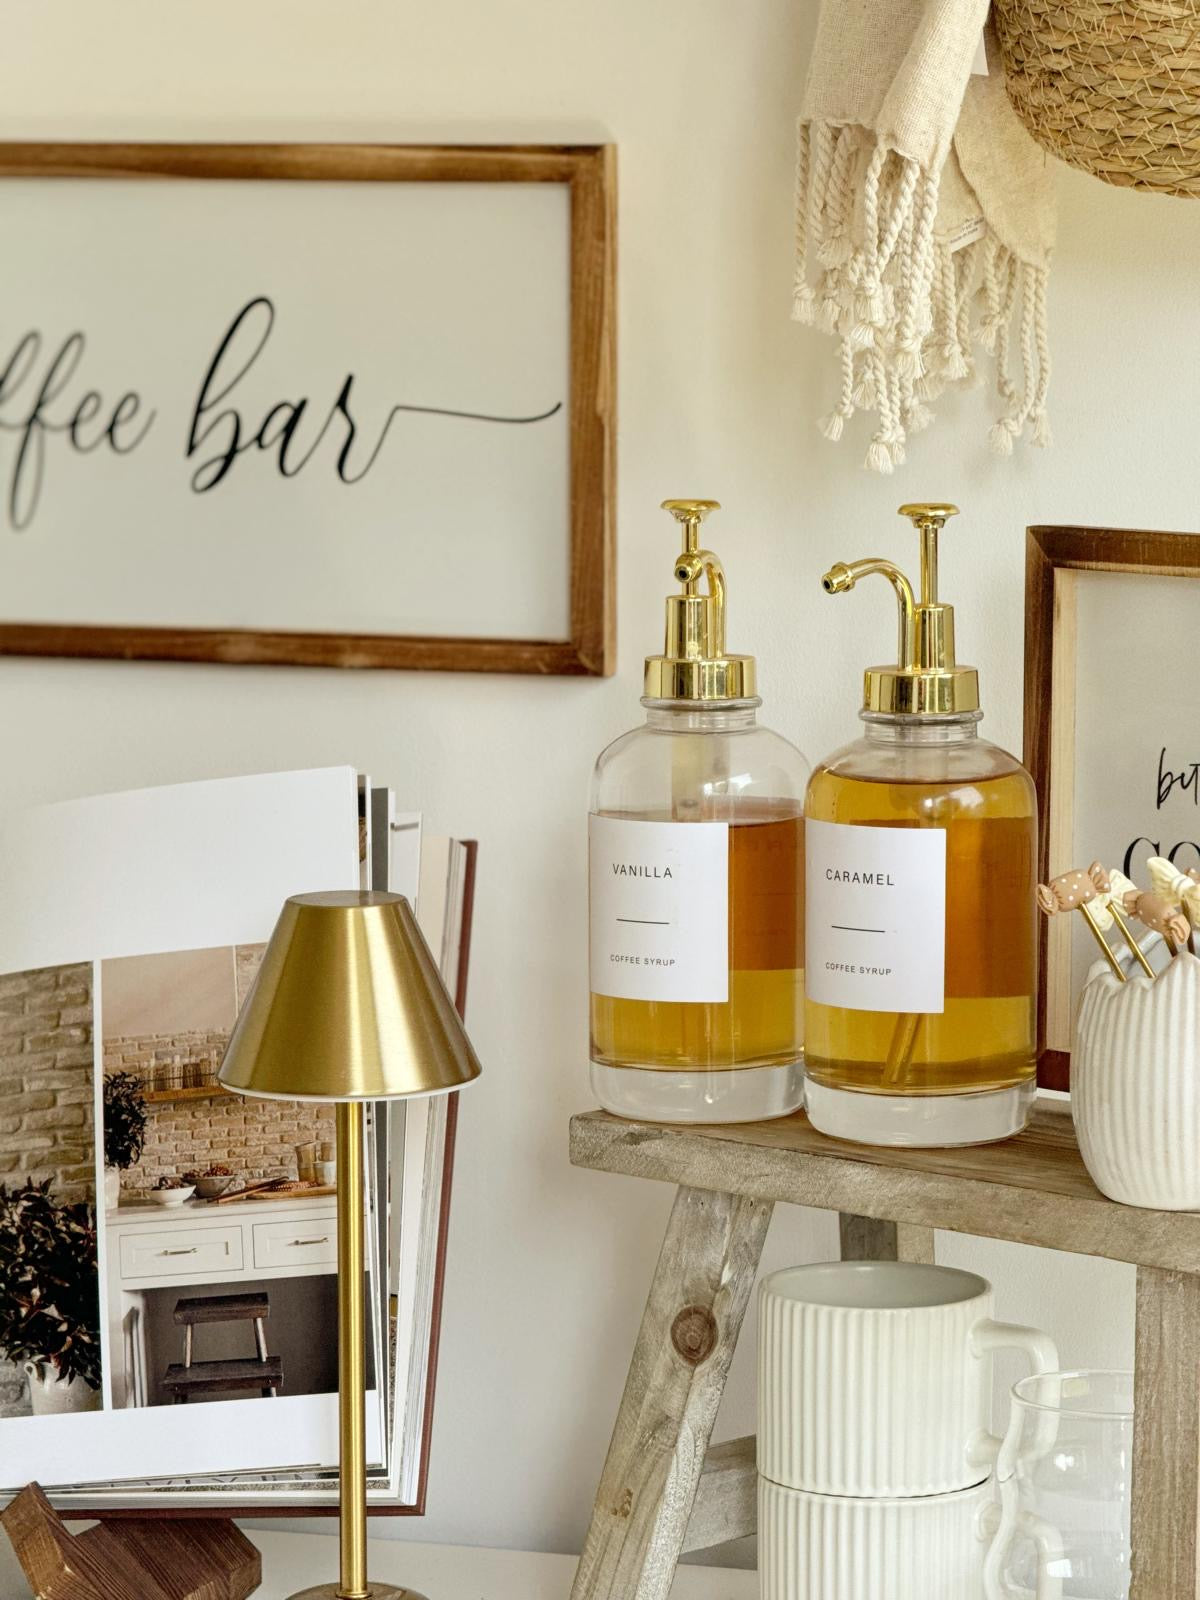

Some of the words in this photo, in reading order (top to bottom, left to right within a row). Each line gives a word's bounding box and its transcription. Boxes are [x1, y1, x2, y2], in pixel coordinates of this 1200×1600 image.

[187, 297, 562, 493] bar
[612, 863, 673, 879] VANILLA
[826, 869, 895, 886] CARAMEL
[610, 954, 640, 964] COFFEE
[644, 957, 675, 967] SYRUP
[825, 962, 856, 973] COFFEE
[859, 967, 892, 976] SYRUP
